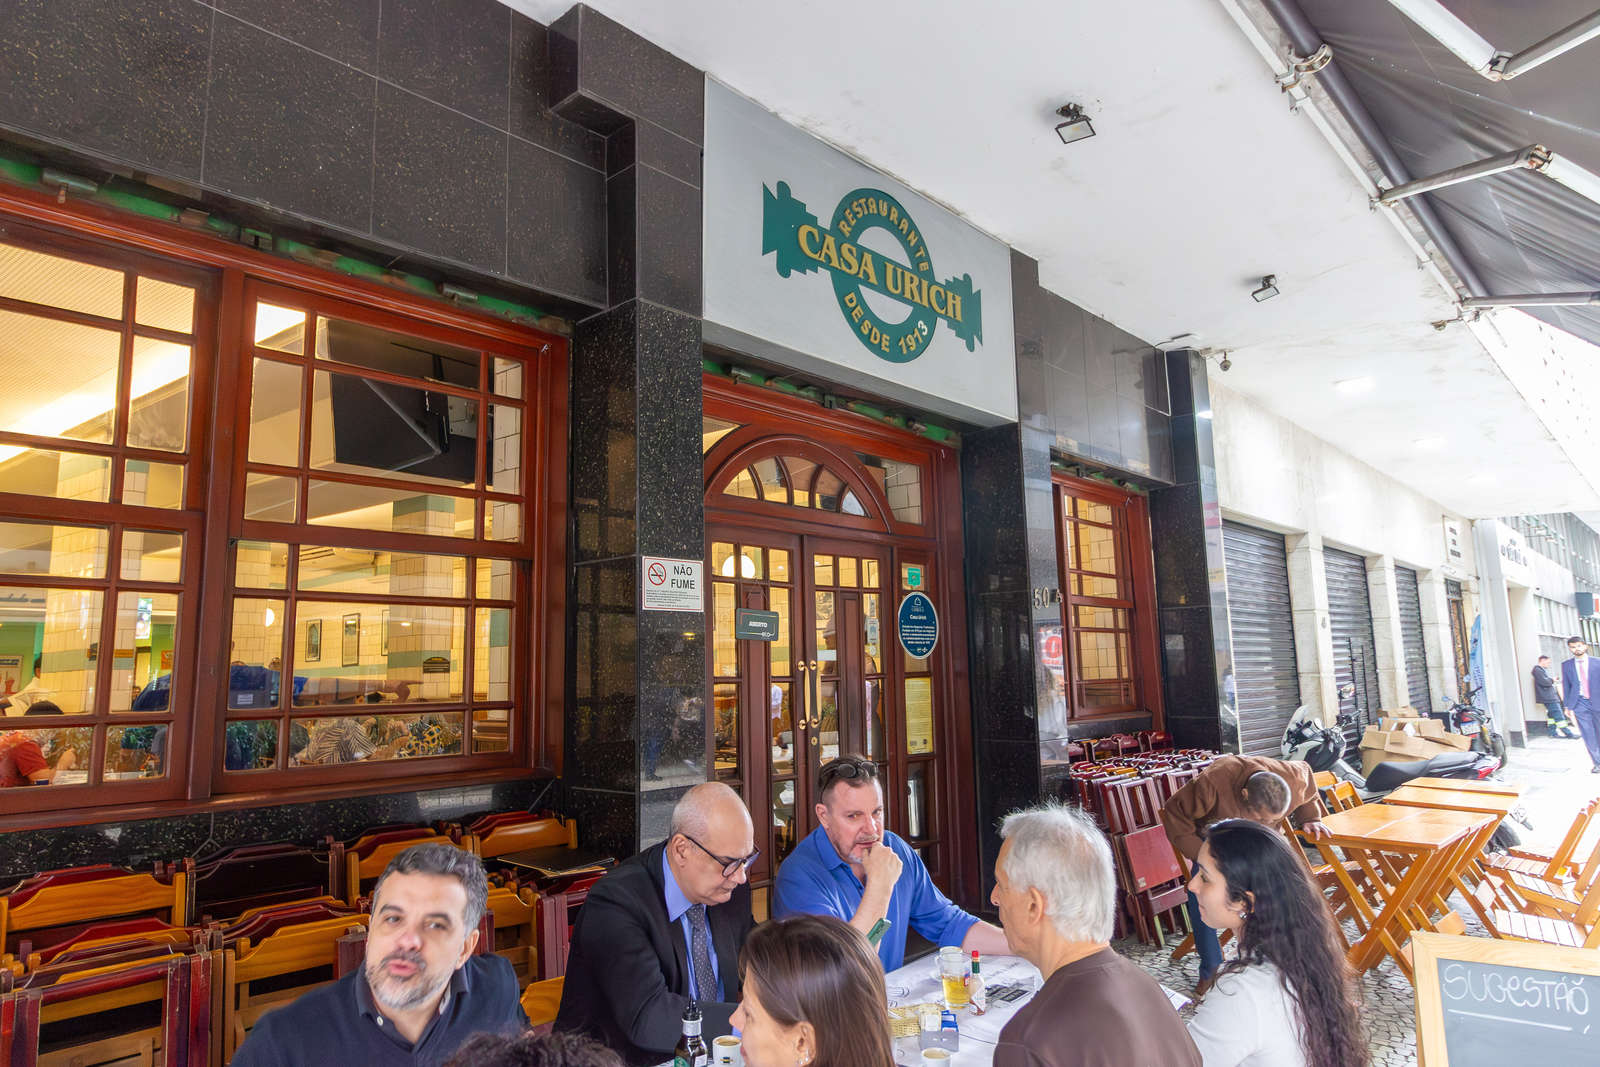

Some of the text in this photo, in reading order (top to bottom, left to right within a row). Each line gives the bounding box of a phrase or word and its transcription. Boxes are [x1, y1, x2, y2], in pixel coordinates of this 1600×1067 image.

[838, 198, 929, 272] RESTAURANTE
[798, 224, 963, 322] CASA URICH
[844, 292, 928, 355] DESDE 1913
[671, 578, 696, 590] FUME
[673, 564, 693, 576] NÃO
[1034, 586, 1050, 609] 50
